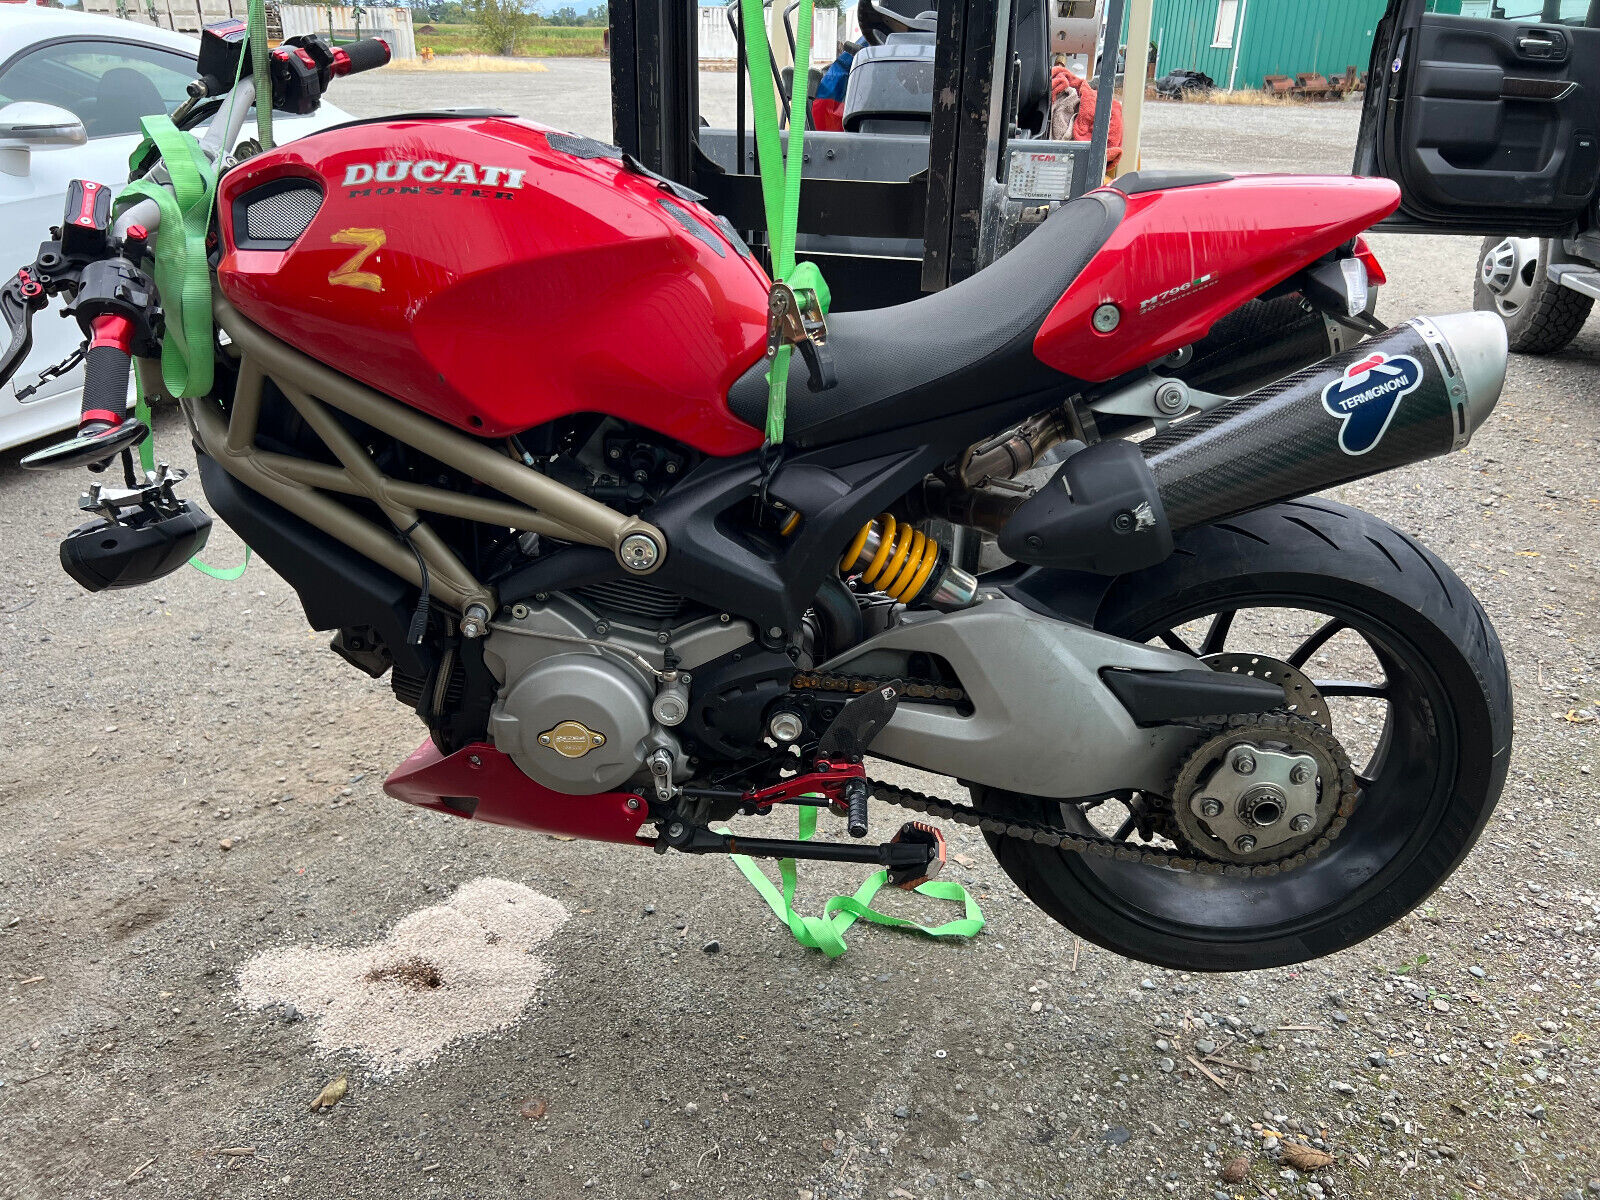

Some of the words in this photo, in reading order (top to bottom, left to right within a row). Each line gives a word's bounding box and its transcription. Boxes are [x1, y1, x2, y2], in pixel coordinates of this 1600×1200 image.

[1031, 154, 1056, 163] TCM
[341, 159, 527, 189] DUCATI
[349, 186, 514, 200] MONSTER
[327, 227, 387, 293] Z
[1139, 282, 1191, 309] M796
[1338, 374, 1409, 411] TERMIGNONI
